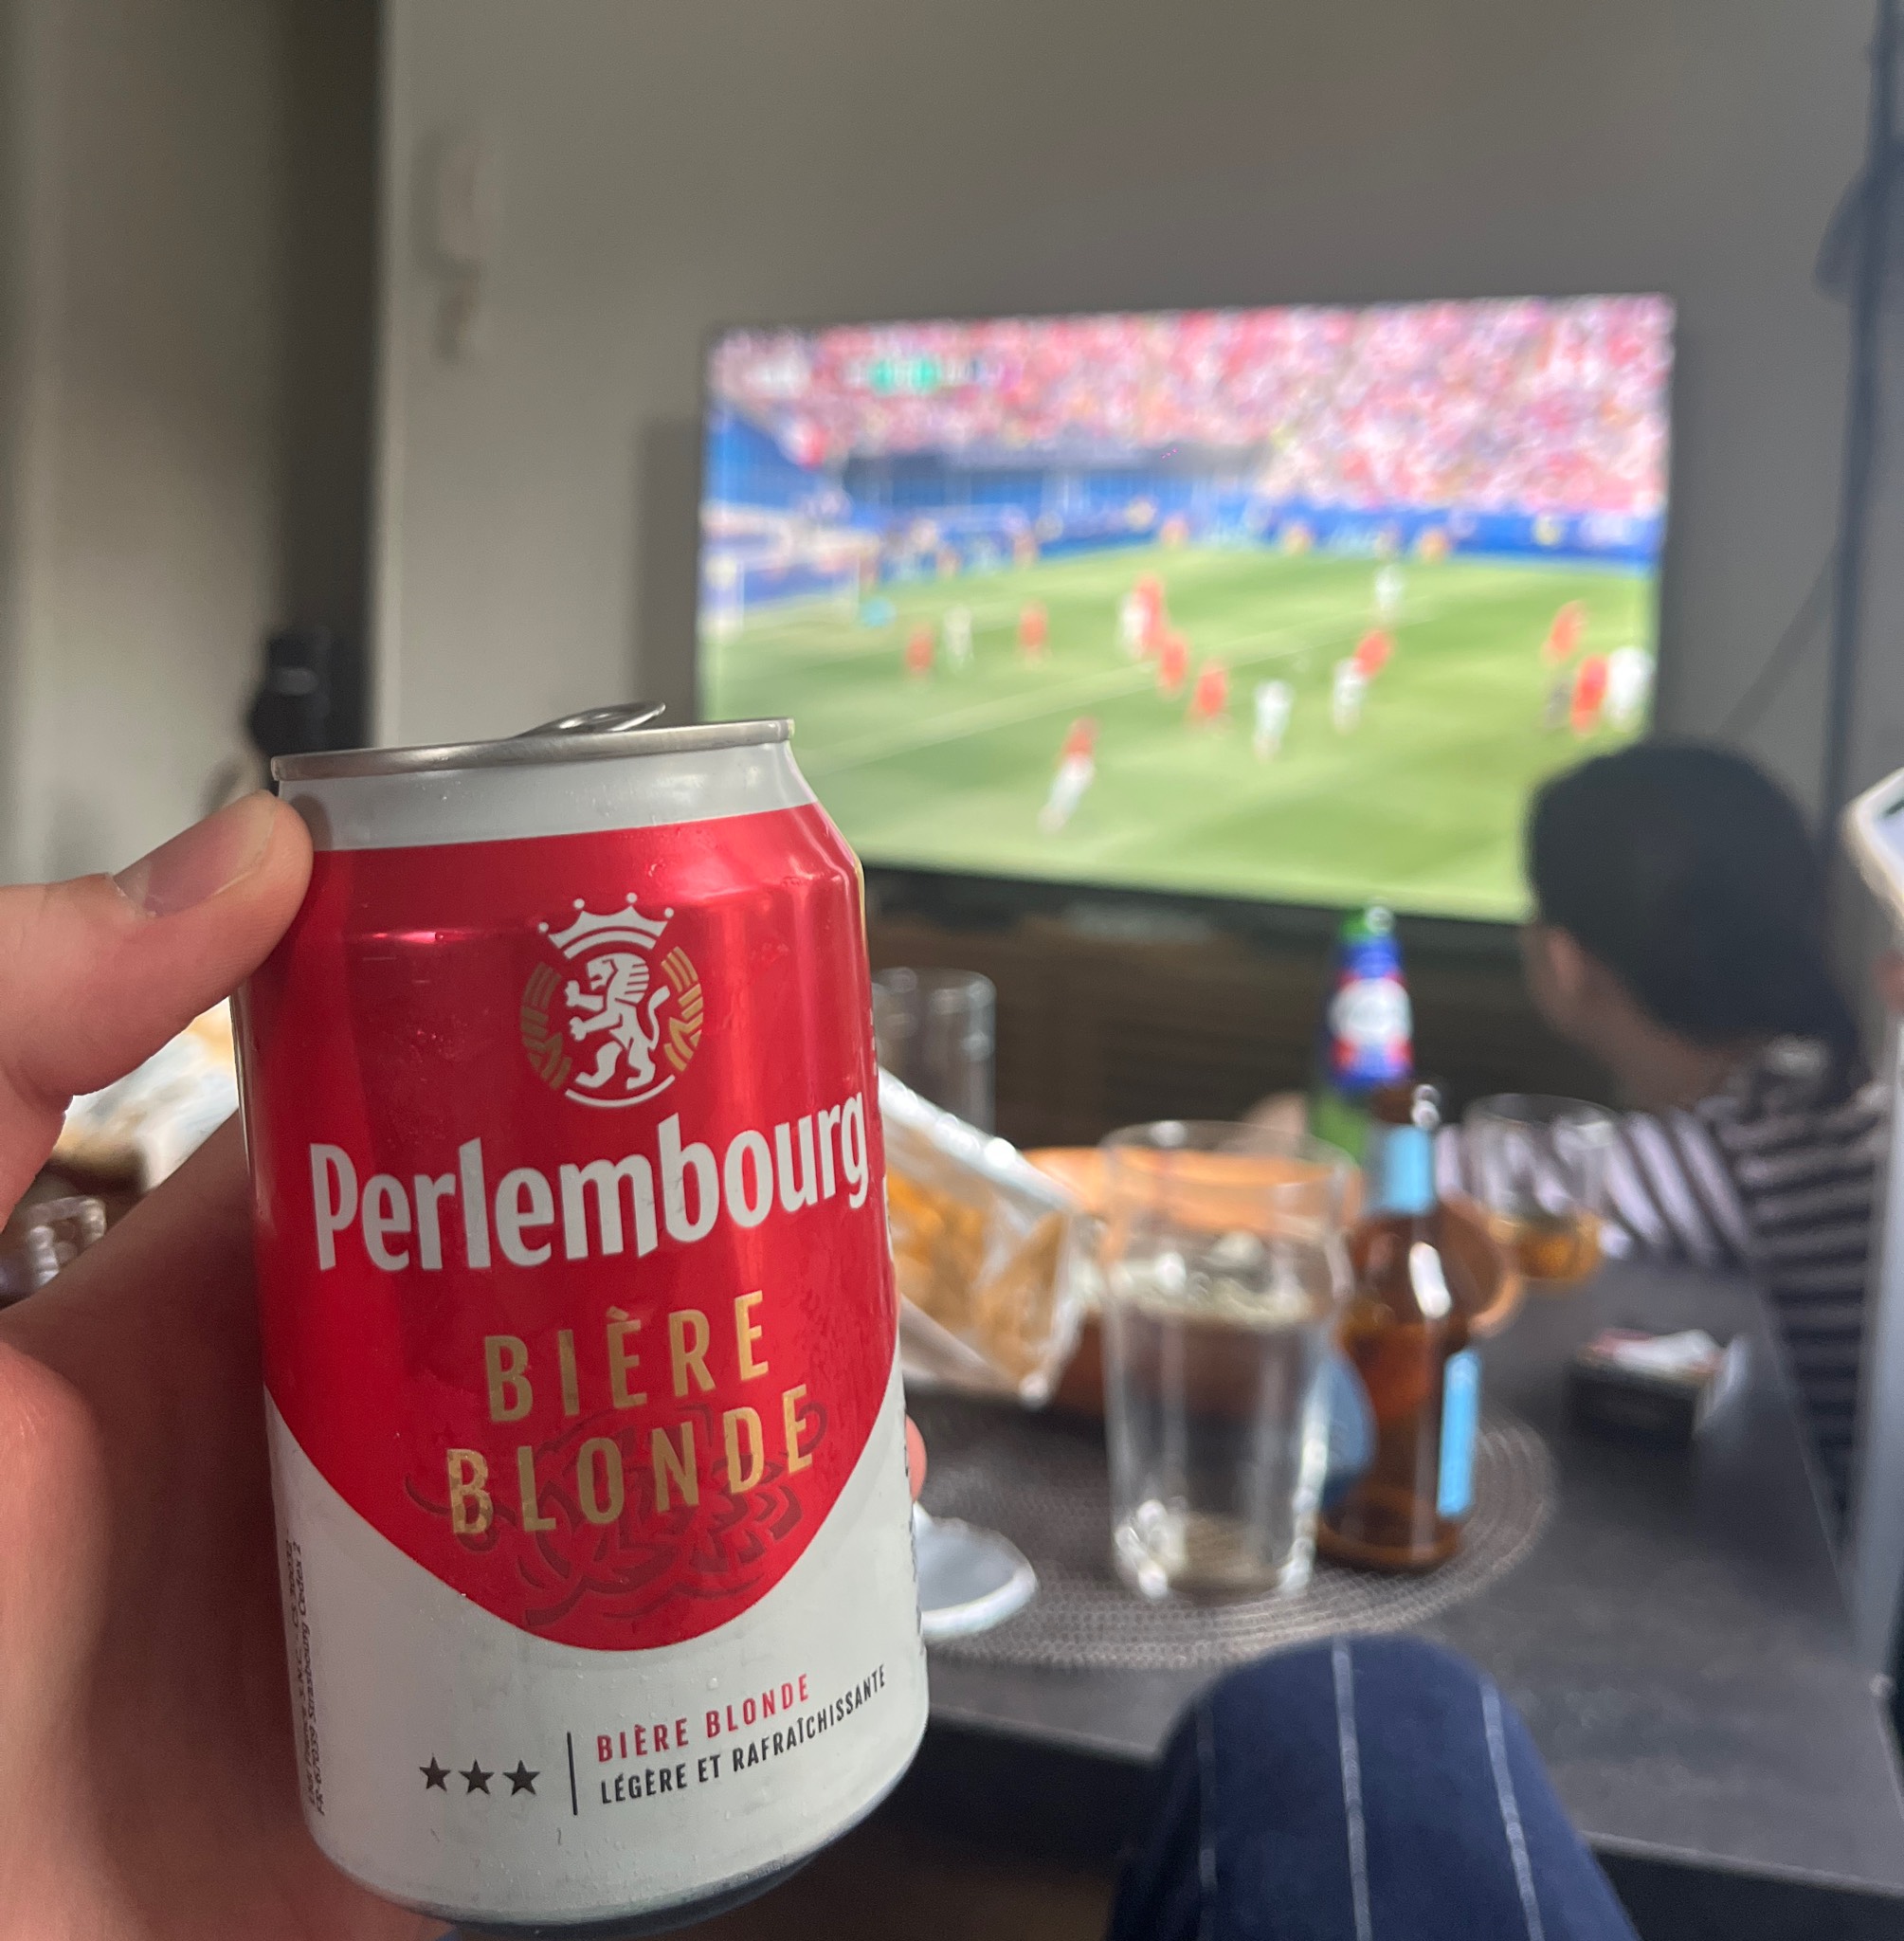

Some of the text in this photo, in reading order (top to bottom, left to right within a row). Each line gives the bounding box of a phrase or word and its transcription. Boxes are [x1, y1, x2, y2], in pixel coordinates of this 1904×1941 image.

[309, 1090, 870, 1273] Perlembourg
[483, 1290, 770, 1423] BIÈRE
[445, 1383, 814, 1535] BLONDE
[296, 1561, 306, 1616] Cedex
[301, 1622, 317, 1723] Strasbourg
[596, 1673, 810, 1763] BIÈRE BLONDE
[600, 1663, 887, 1805] LÉGÈRE ET RAFRAÎCHISSANTE
